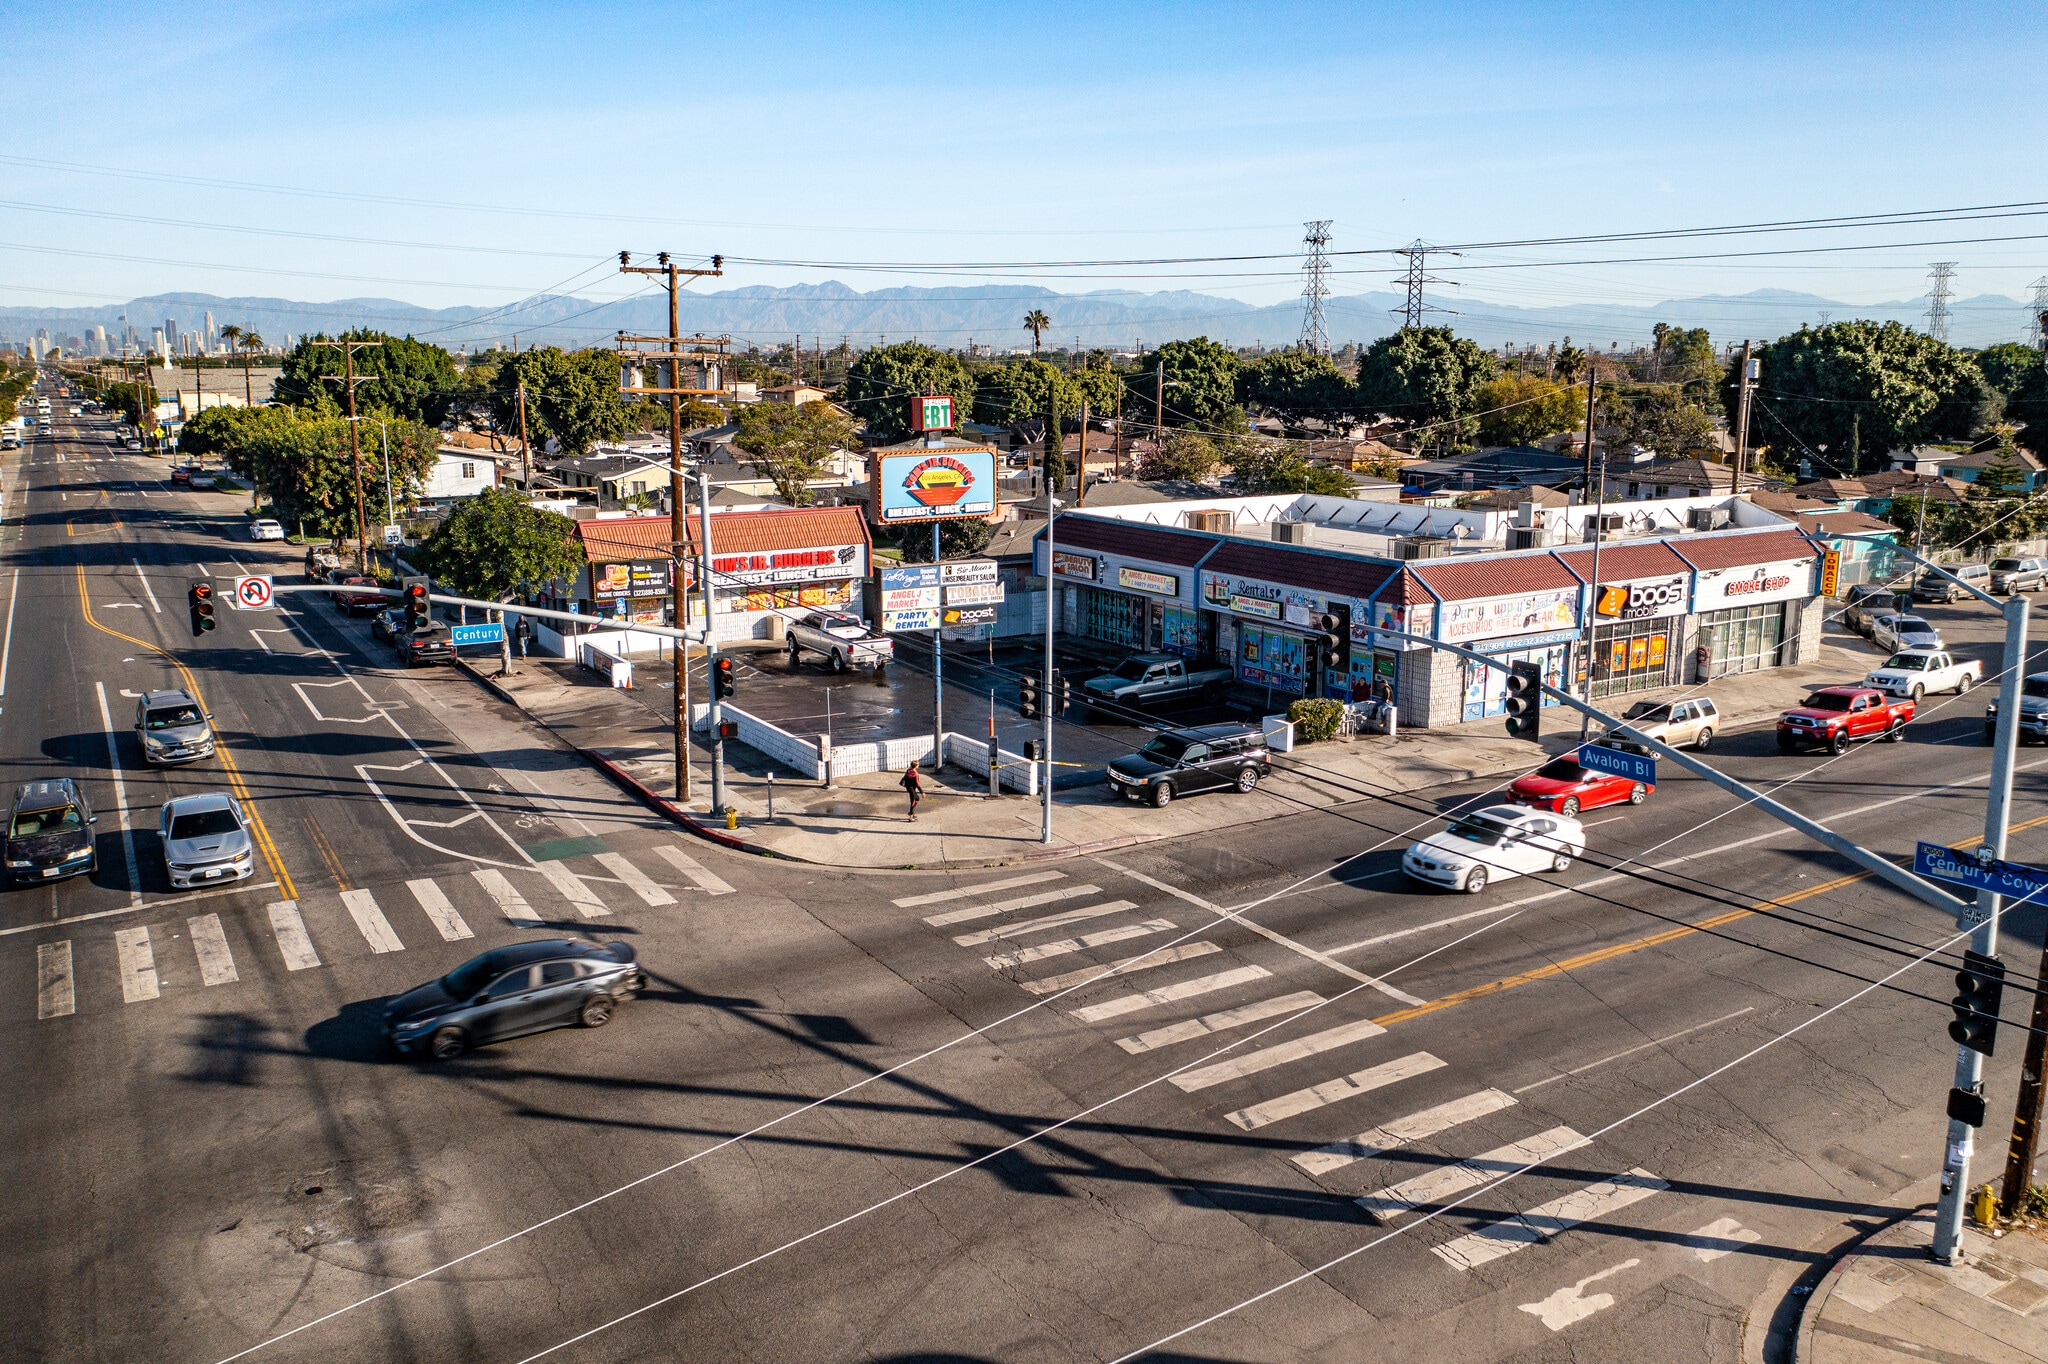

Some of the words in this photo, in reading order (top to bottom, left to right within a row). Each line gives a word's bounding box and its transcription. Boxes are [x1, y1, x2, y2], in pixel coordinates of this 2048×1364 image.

[924, 405, 950, 428] EBT
[904, 461, 929, 487] TOM'S
[941, 456, 975, 485] BURGERS
[887, 506, 930, 518] BREAKFAST
[935, 504, 960, 515] LUNCH
[964, 502, 991, 512] DINNER
[713, 556, 748, 572] OM'S
[750, 555, 770, 570] JR.
[774, 550, 835, 568] BURGERS
[1065, 554, 1092, 567] BEAUTY
[1067, 562, 1090, 574] SALON
[713, 573, 767, 586] REAKFAST
[774, 569, 808, 582] LUNCH
[817, 566, 854, 578] DINNER
[957, 567, 968, 575] Sir
[1128, 571, 1143, 580] ANGEL
[1147, 574, 1167, 584] MARKET
[1824, 551, 1836, 595] TOBACCO
[948, 584, 1003, 599] TOBACCO
[1238, 580, 1275, 599] Rentals
[1629, 580, 1688, 608] boost
[1728, 580, 1760, 595] SMOKE
[1765, 577, 1791, 590] SHOP
[891, 591, 916, 600] ANGEL
[916, 590, 922, 598] J
[1237, 597, 1250, 605] ANGEL
[1254, 601, 1272, 609] MARKET
[887, 599, 919, 609] MARKET
[1625, 603, 1659, 618] mobile
[897, 611, 928, 621] PARTY
[960, 607, 994, 619] boost
[1451, 604, 1484, 621] Party
[895, 621, 928, 630] RENTAL
[1449, 619, 1493, 637] ACCESORIOS
[1512, 615, 1522, 628] EL
[455, 629, 500, 641] Century
[1475, 643, 1488, 652] 213
[1489, 640, 1504, 650] 909
[1506, 639, 1522, 648] 1072
[1525, 636, 1538, 646] 323
[1585, 750, 1628, 771] Avalon
[1635, 761, 1649, 777] Bl
[1926, 855, 1992, 883] Century
[2001, 872, 2044, 894] Cove
